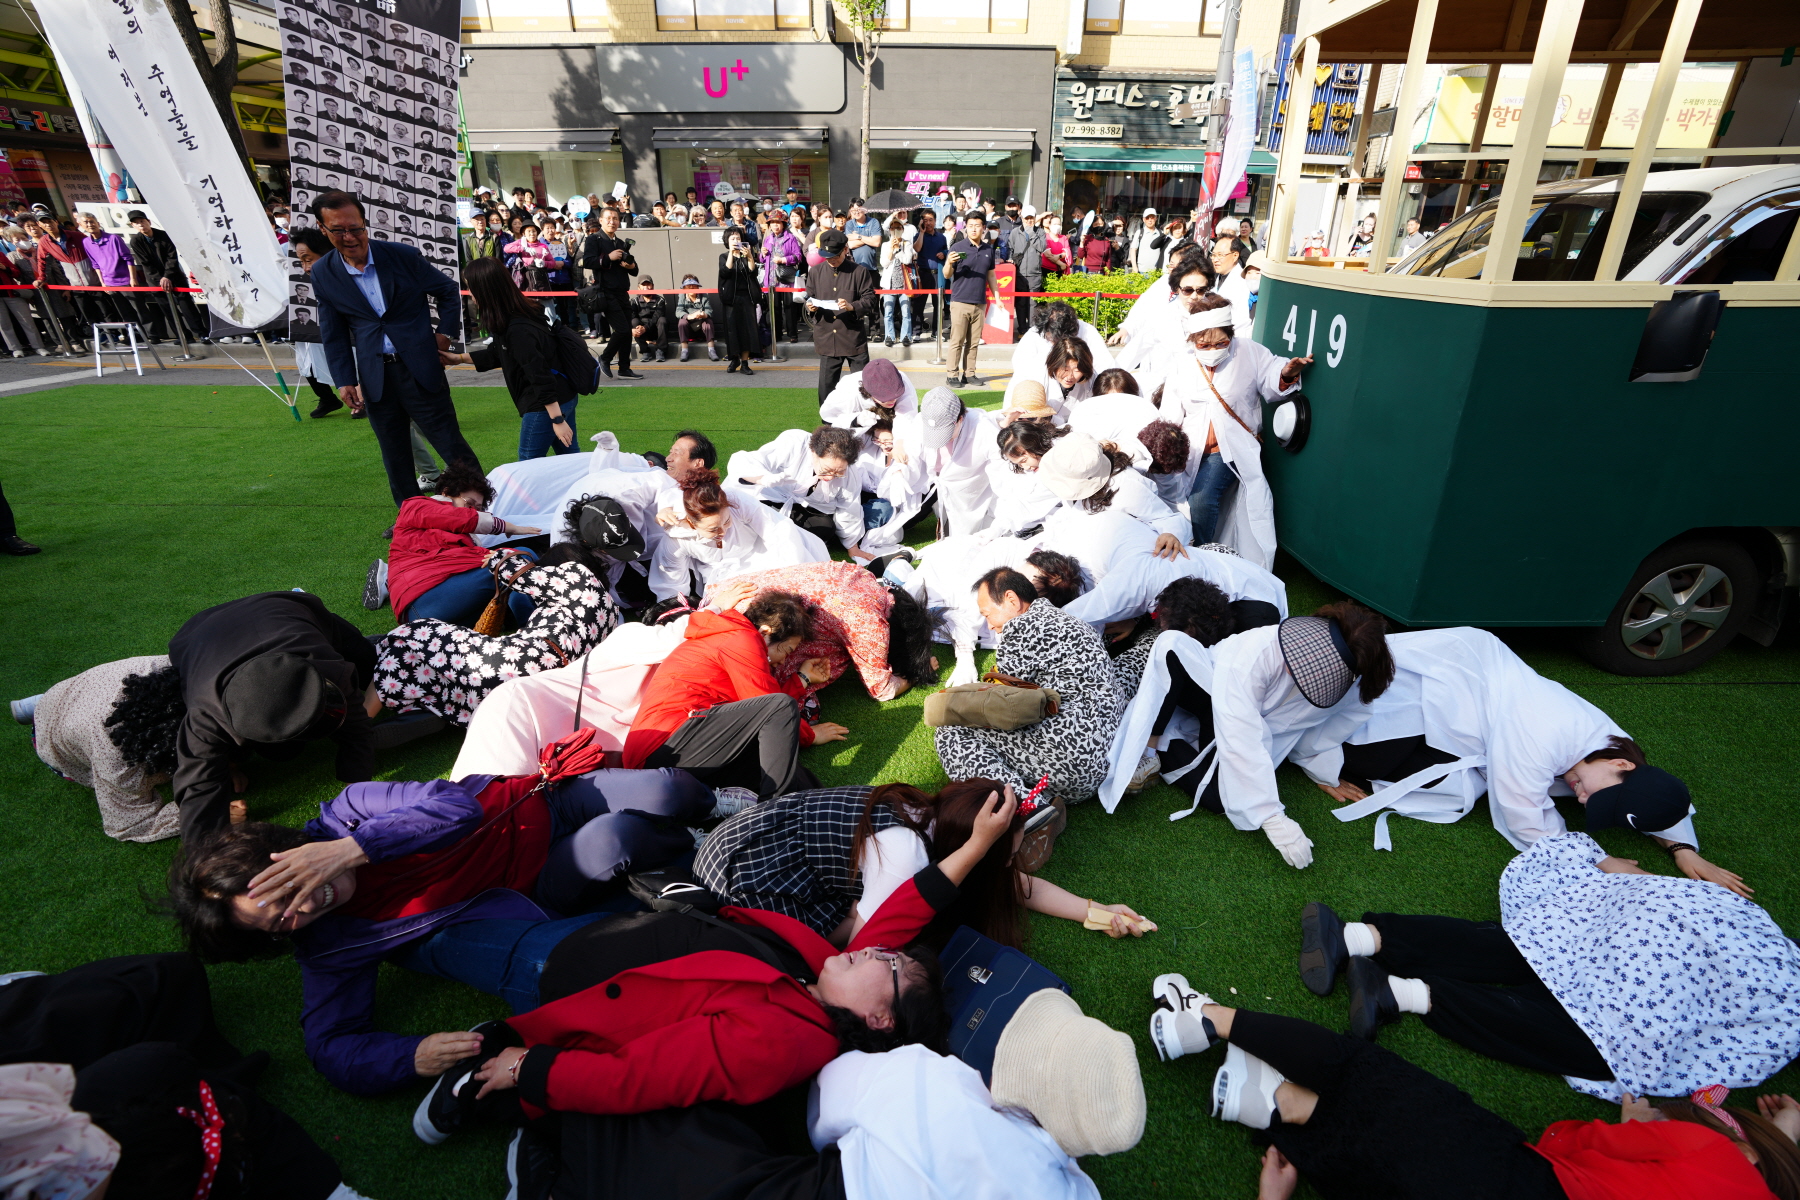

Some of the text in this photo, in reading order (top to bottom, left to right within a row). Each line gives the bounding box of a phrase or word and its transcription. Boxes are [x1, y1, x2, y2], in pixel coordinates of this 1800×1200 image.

[702, 58, 750, 99] U+
[1064, 125, 1121, 136] 02-998-8382
[148, 63, 198, 151] 주역들을
[200, 174, 259, 302] 기억하십니까?
[1282, 304, 1347, 369] 419
